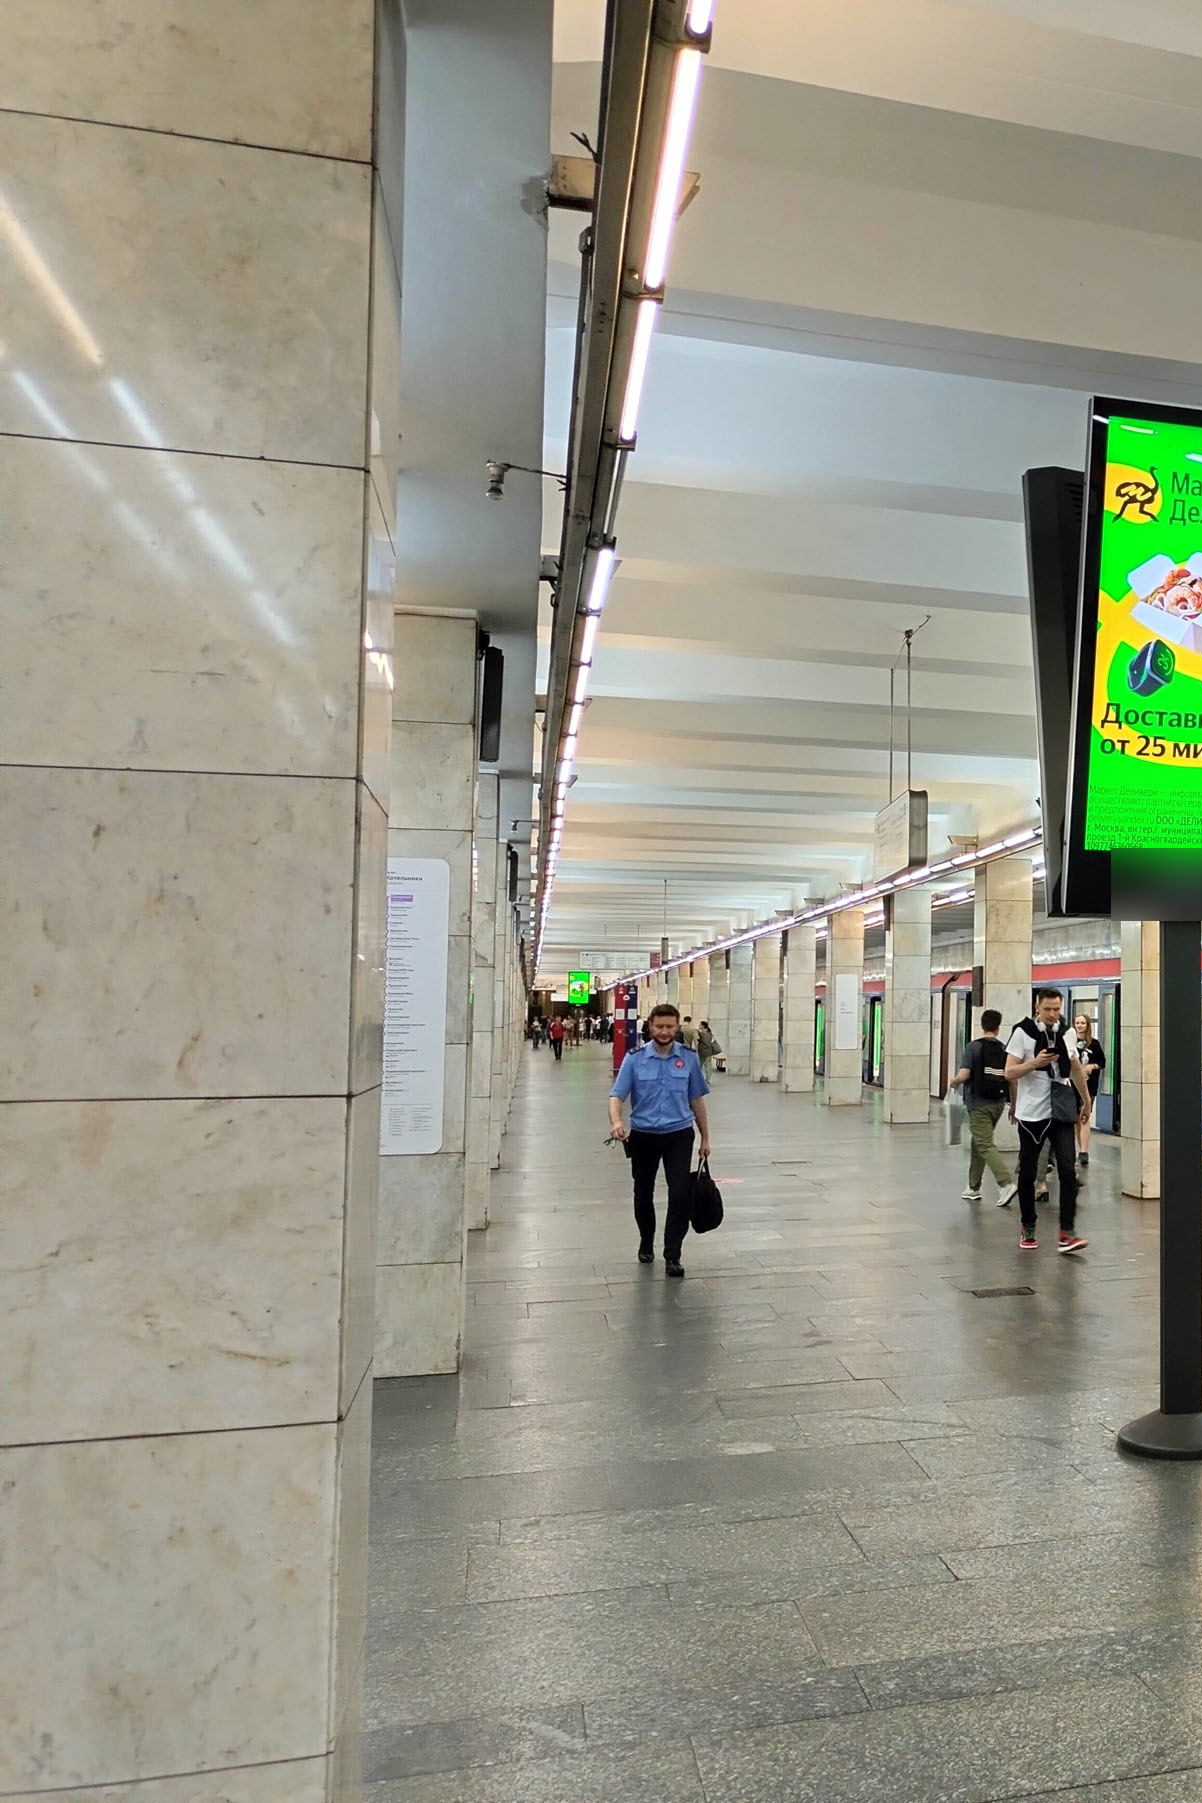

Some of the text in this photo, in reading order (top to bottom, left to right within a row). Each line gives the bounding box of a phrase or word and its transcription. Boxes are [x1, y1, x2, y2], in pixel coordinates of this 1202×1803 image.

[1099, 737, 1130, 755] от
[1136, 735, 1167, 758] 25
[1089, 785, 1118, 795] Маркет
[1156, 816, 1174, 825] ООО
[1087, 833, 1116, 843] проезд
